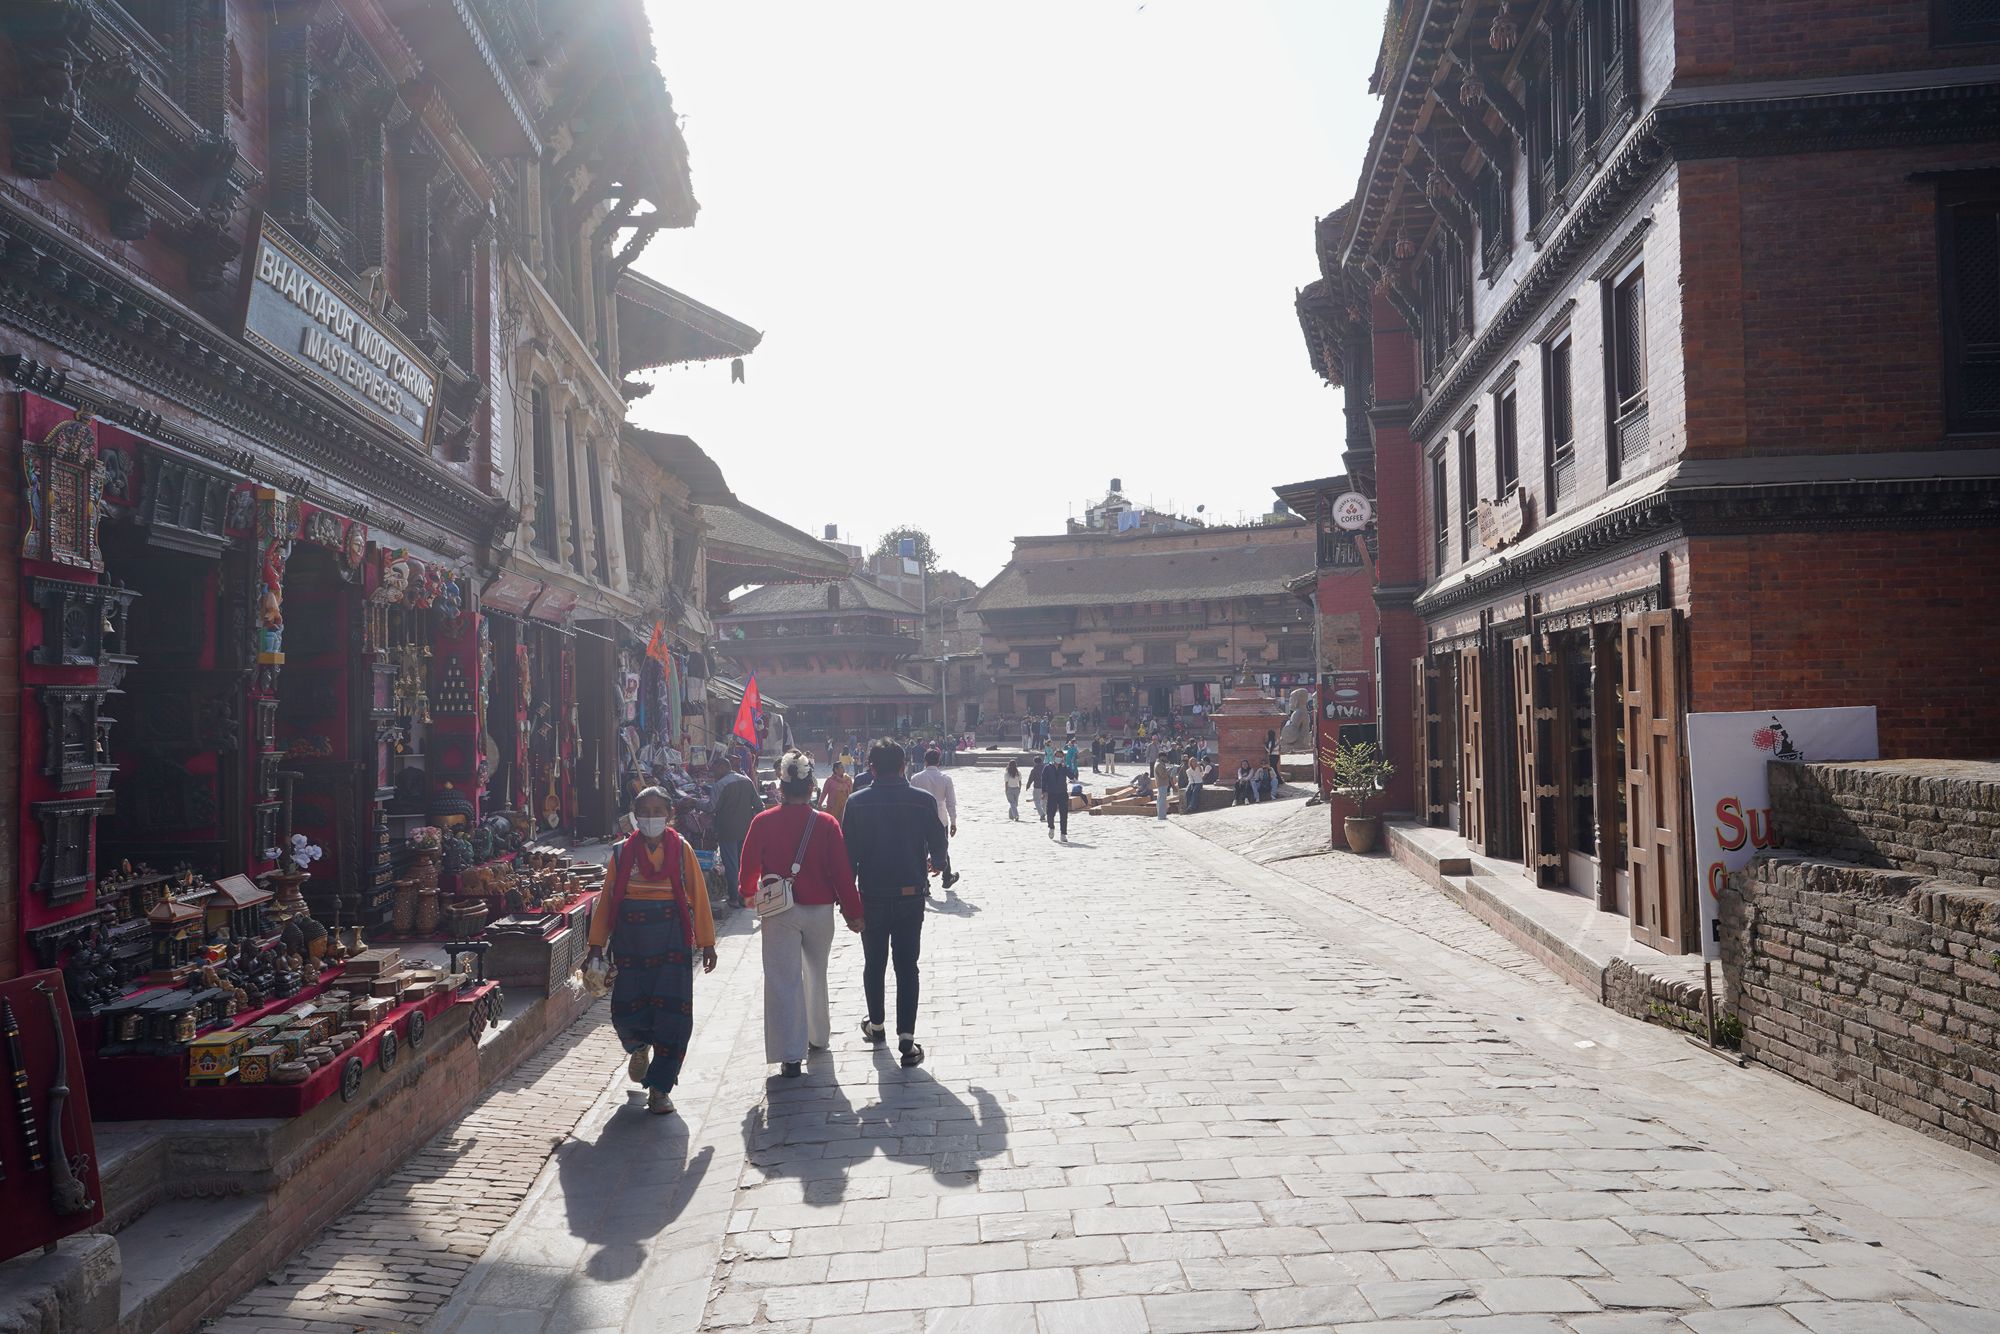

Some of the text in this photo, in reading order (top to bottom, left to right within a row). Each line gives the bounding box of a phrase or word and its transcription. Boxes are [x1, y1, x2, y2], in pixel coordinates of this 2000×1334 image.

[258, 246, 434, 408] BHAKTAPUR WOOD CARVING
[305, 328, 403, 416] MASTERPIECES
[1341, 514, 1363, 522] COFFEE
